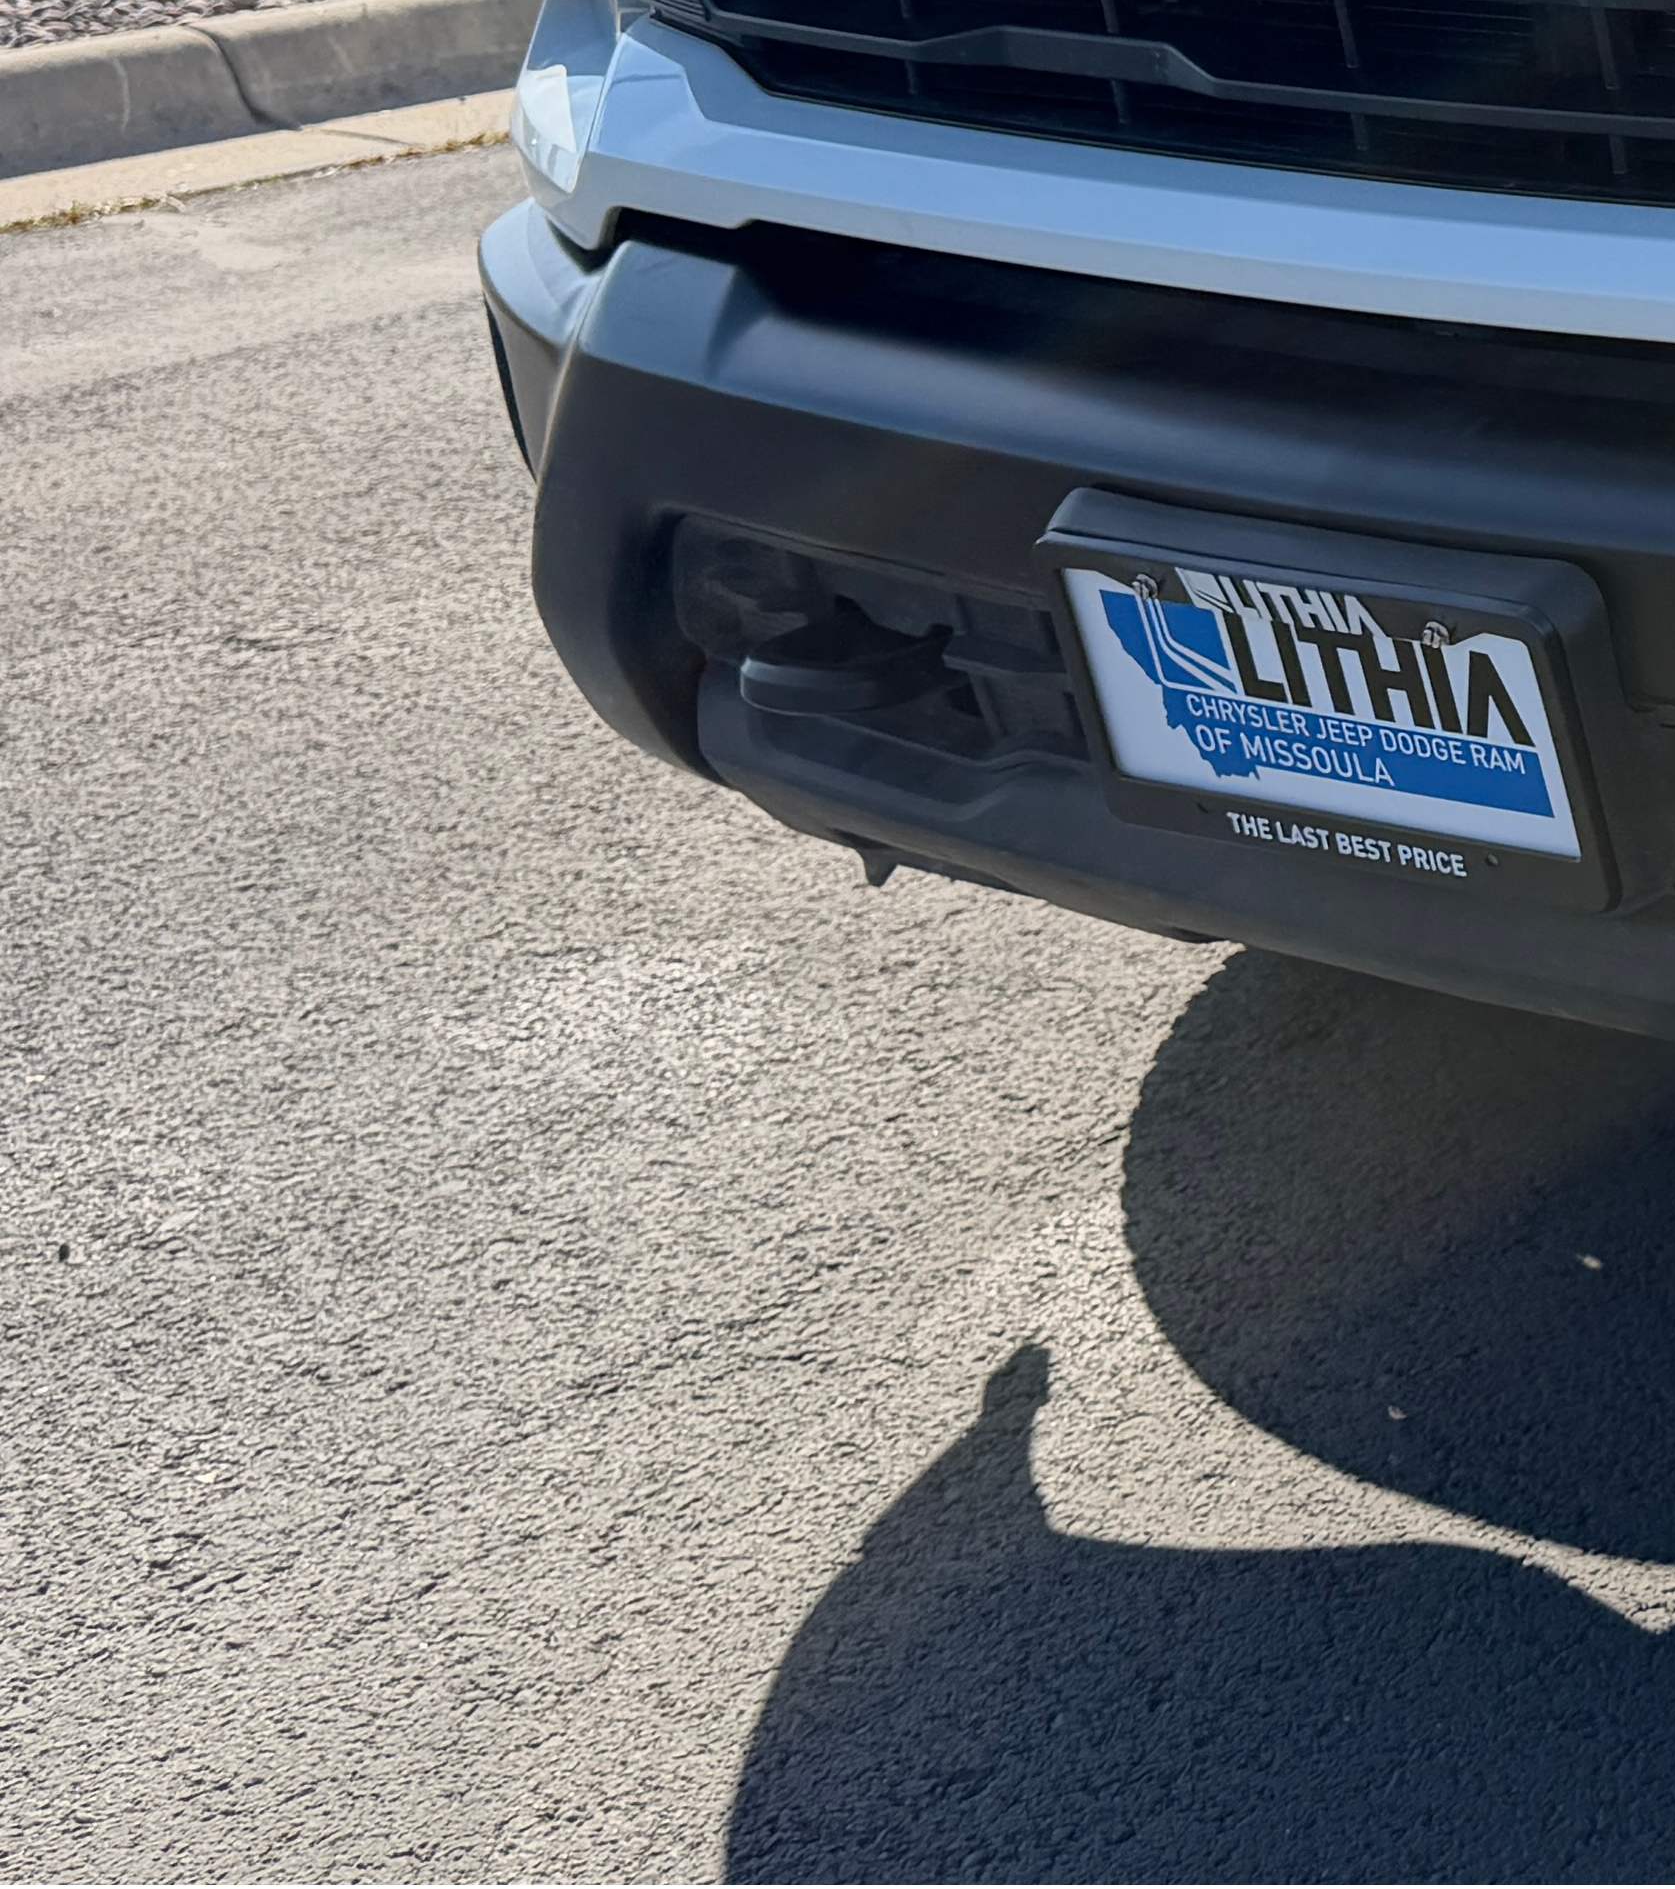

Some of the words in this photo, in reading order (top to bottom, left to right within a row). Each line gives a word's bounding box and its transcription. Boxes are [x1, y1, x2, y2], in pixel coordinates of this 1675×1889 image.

[1217, 574, 1390, 639] LITHIA
[1223, 611, 1535, 747] LITHIA
[1186, 693, 1310, 738] CHRYSLER
[1316, 717, 1373, 748] JEEP
[1381, 728, 1467, 766] DODGE
[1472, 741, 1526, 775] RAM
[1195, 723, 1233, 754] OF
[1240, 733, 1395, 788] MISSOULA
[1226, 812, 1273, 841] THE
[1276, 821, 1330, 852] LAST
[1335, 831, 1393, 864] BEST
[1398, 844, 1468, 878] PRICE
